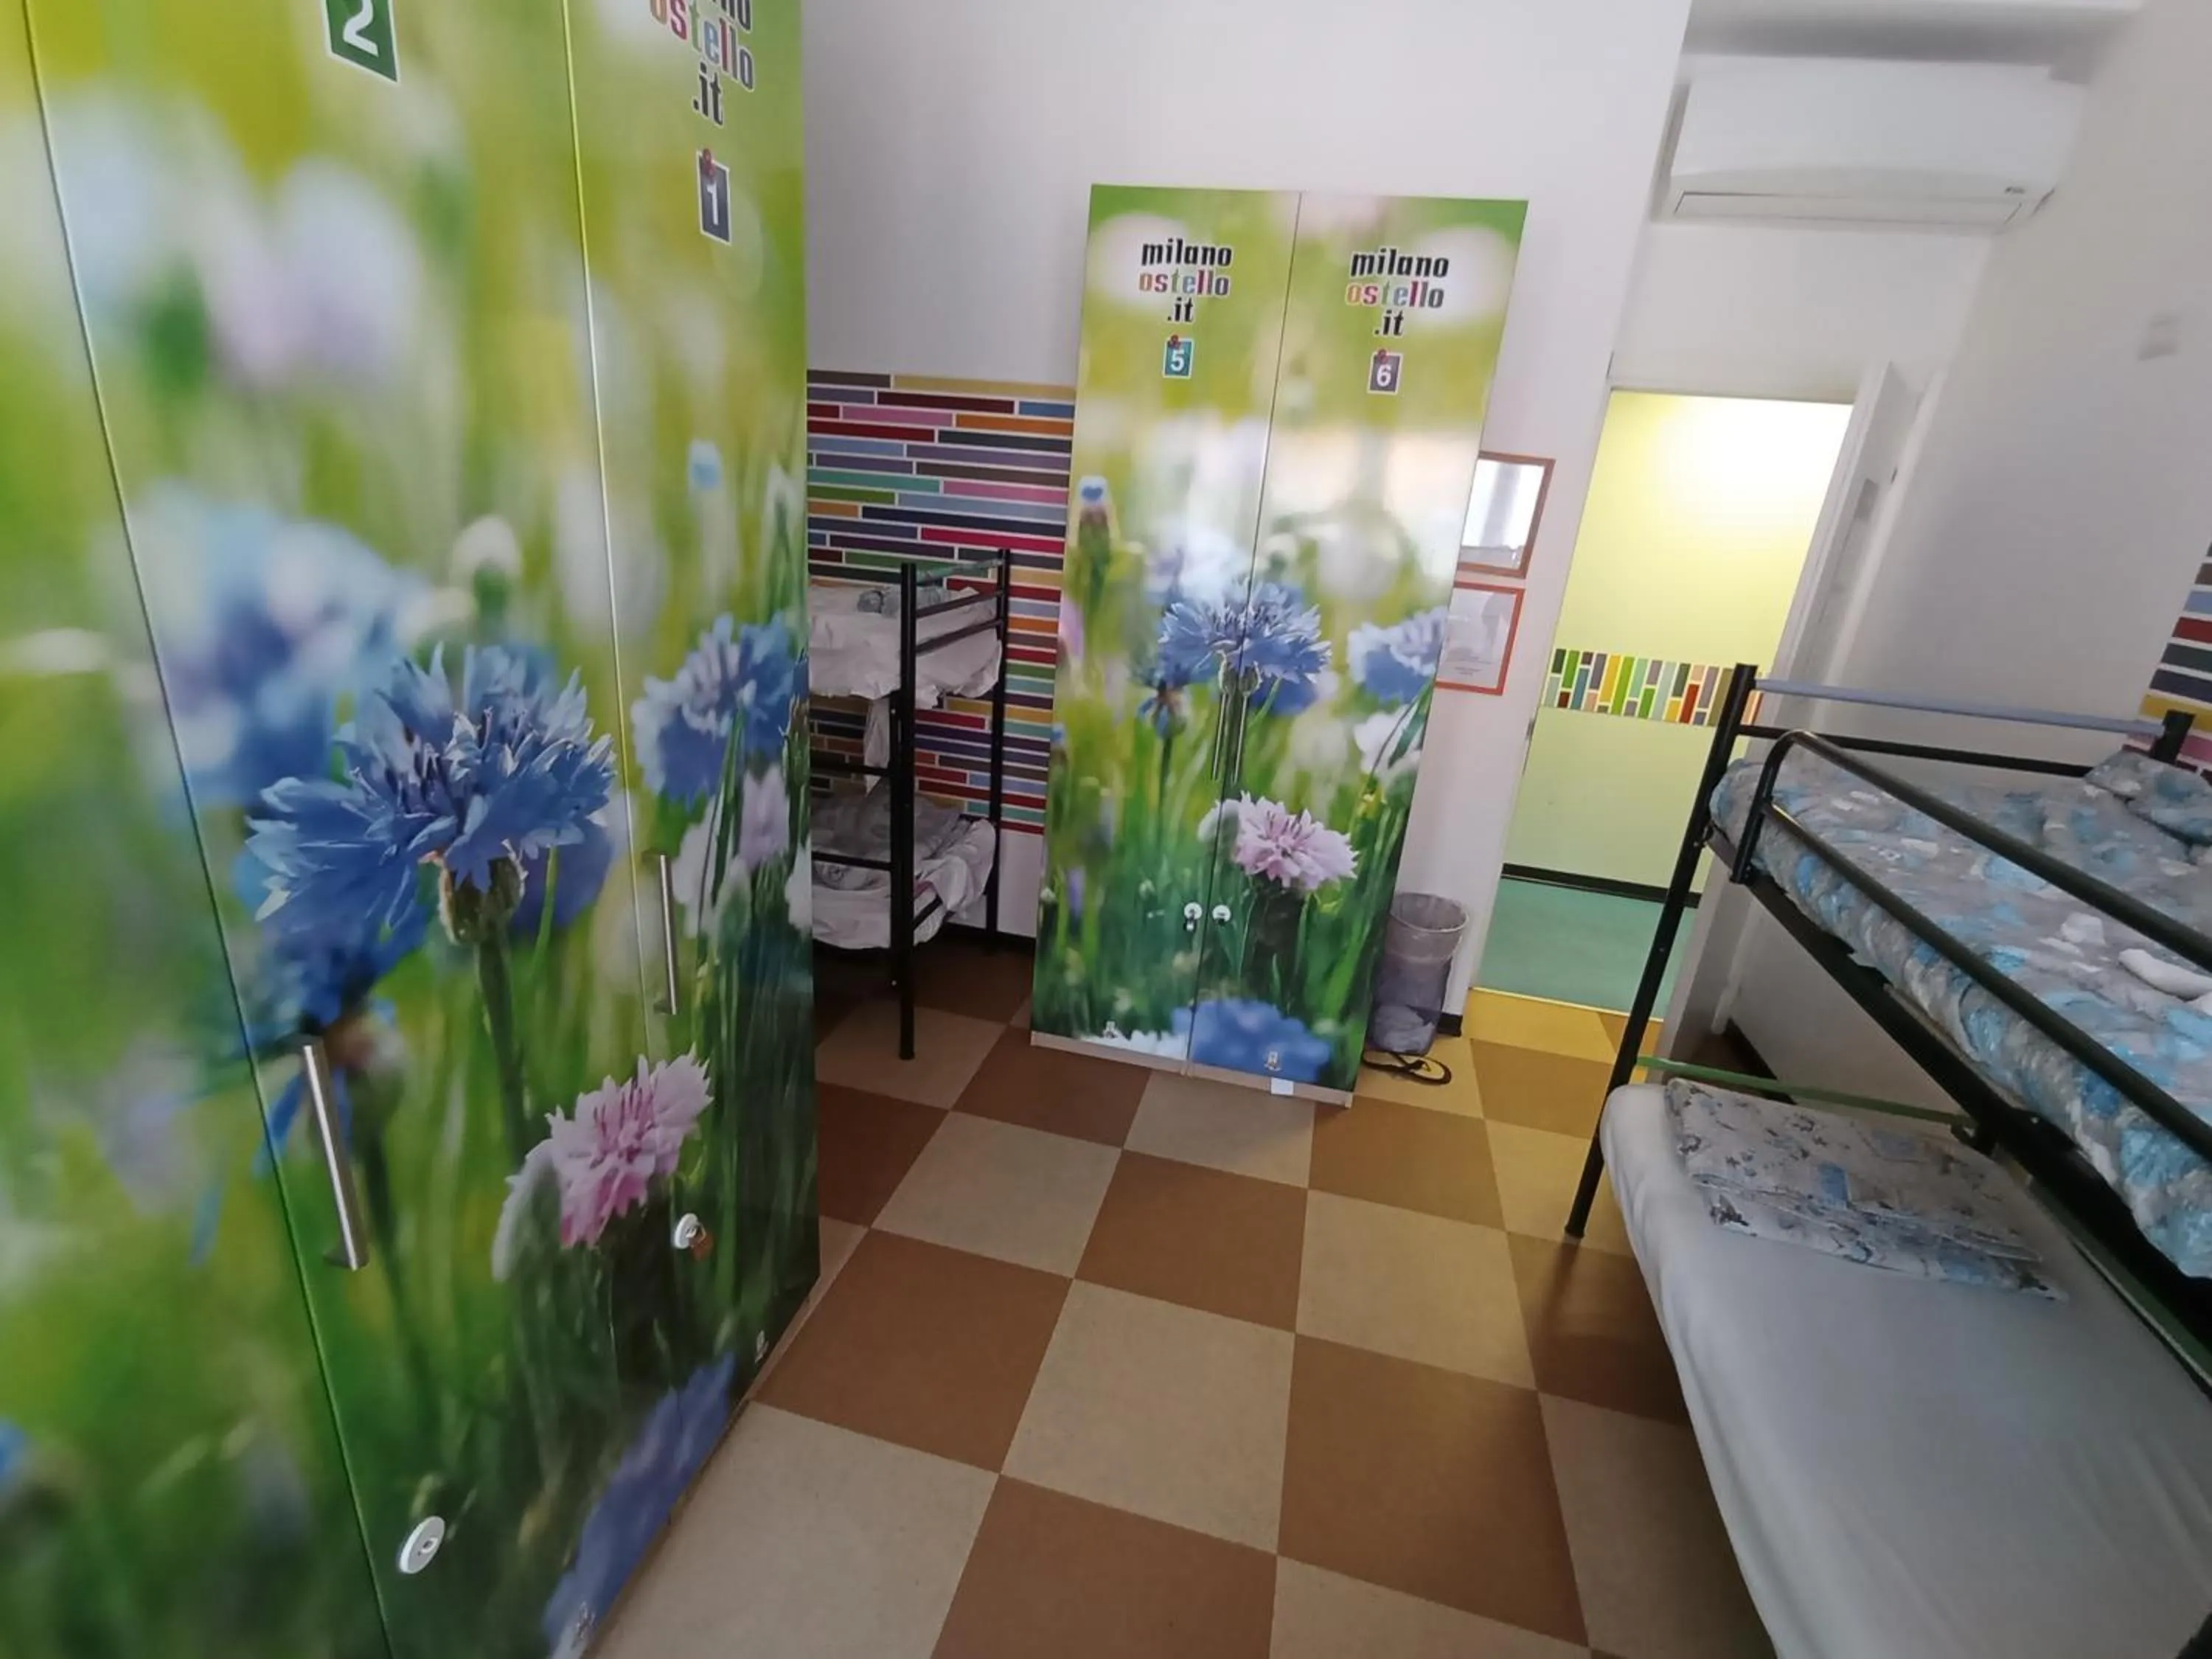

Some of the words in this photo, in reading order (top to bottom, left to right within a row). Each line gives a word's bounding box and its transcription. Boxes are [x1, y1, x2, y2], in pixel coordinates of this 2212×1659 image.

[342, 0, 380, 58] 2
[693, 61, 723, 125] .it
[706, 181, 719, 226] 1
[1141, 237, 1232, 267] milano
[1350, 247, 1450, 278] milano
[1139, 268, 1230, 296] ostello
[1346, 280, 1445, 309] ostello
[1167, 296, 1194, 322] .it
[1374, 309, 1404, 336] .it
[1170, 349, 1185, 372] 5
[1376, 364, 1392, 387] 6
